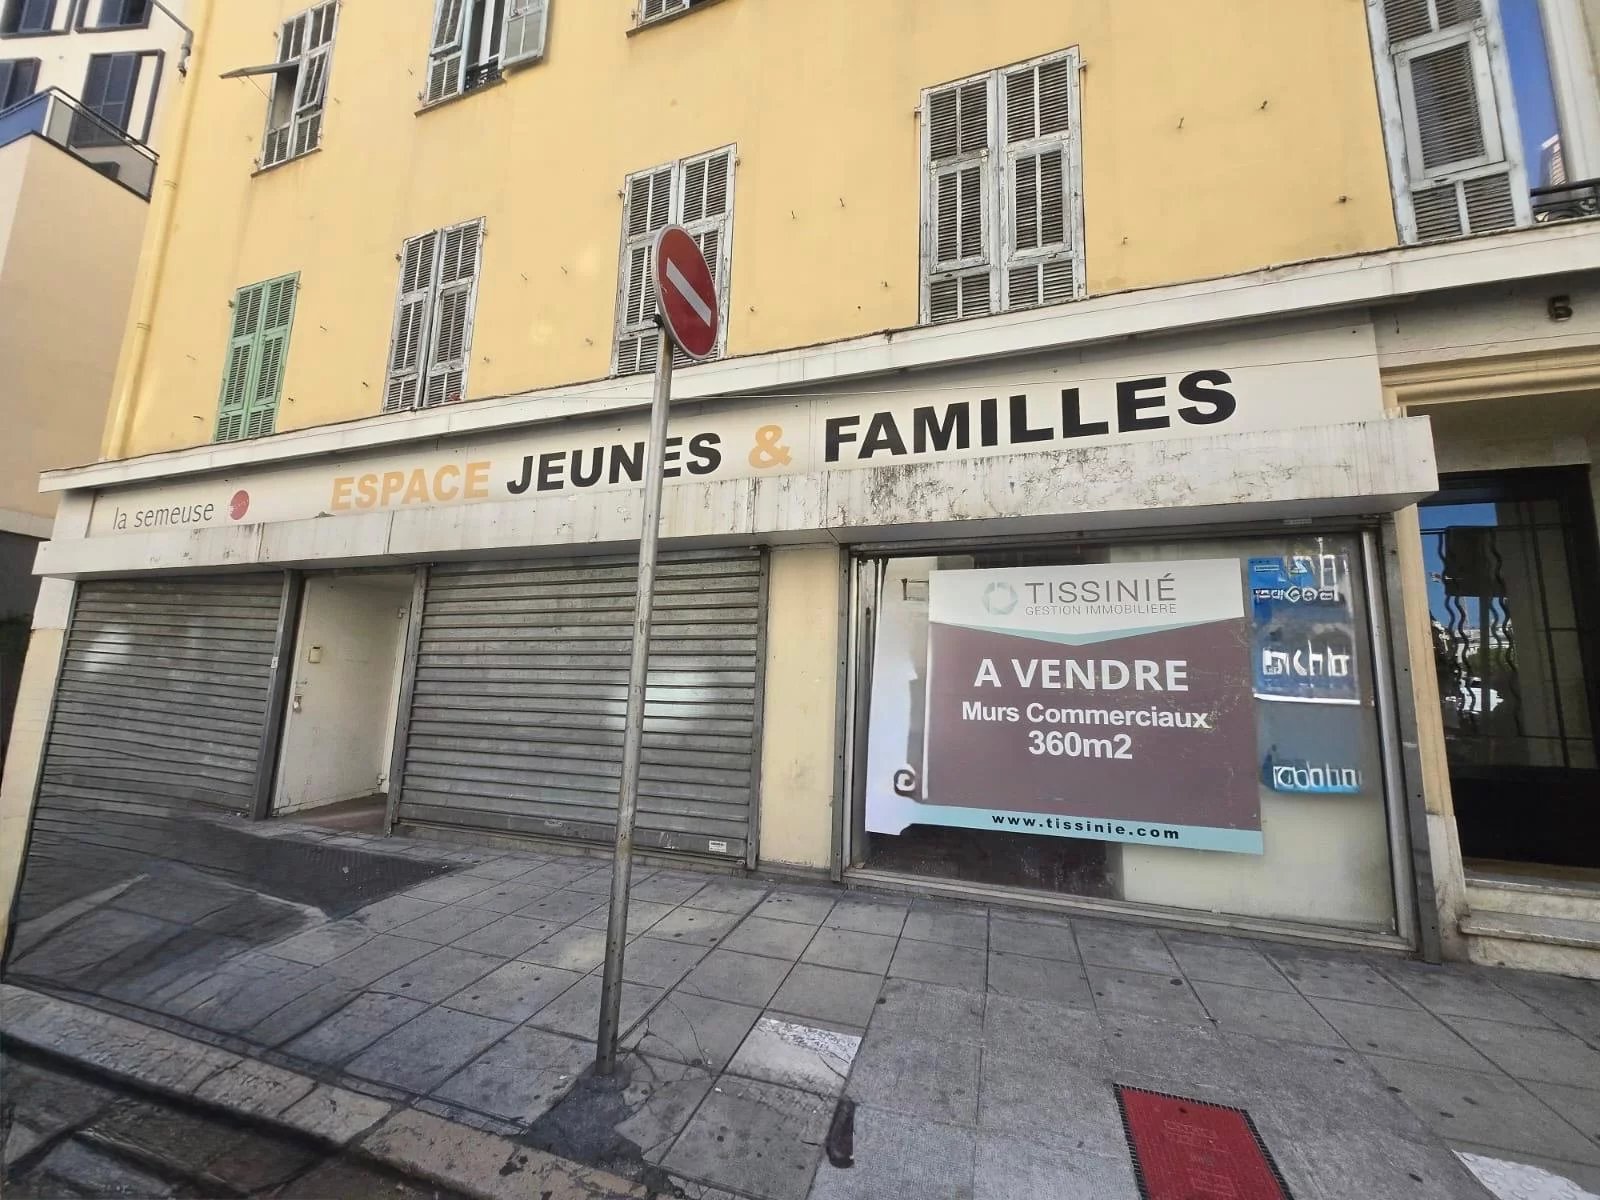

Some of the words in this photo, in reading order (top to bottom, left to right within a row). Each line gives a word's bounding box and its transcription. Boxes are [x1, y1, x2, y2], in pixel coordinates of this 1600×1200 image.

[331, 461, 492, 511] ESPACE
[508, 432, 722, 495] JEUNES
[749, 425, 791, 468] &
[825, 369, 1237, 462] FAMILLES
[113, 507, 127, 530] la
[134, 503, 214, 528] semeuse
[1025, 573, 1176, 604] TISSINIÉ
[1025, 605, 1081, 616] GESTION
[1086, 603, 1177, 615] IMMOBILIERE
[974, 658, 1002, 688] A
[1011, 659, 1189, 692] VENDRE
[962, 701, 1020, 722] Murs
[1026, 702, 1211, 729] Commerciaux
[1028, 730, 1133, 760] 360m2
[992, 815, 1179, 840] www.tissinie.com
